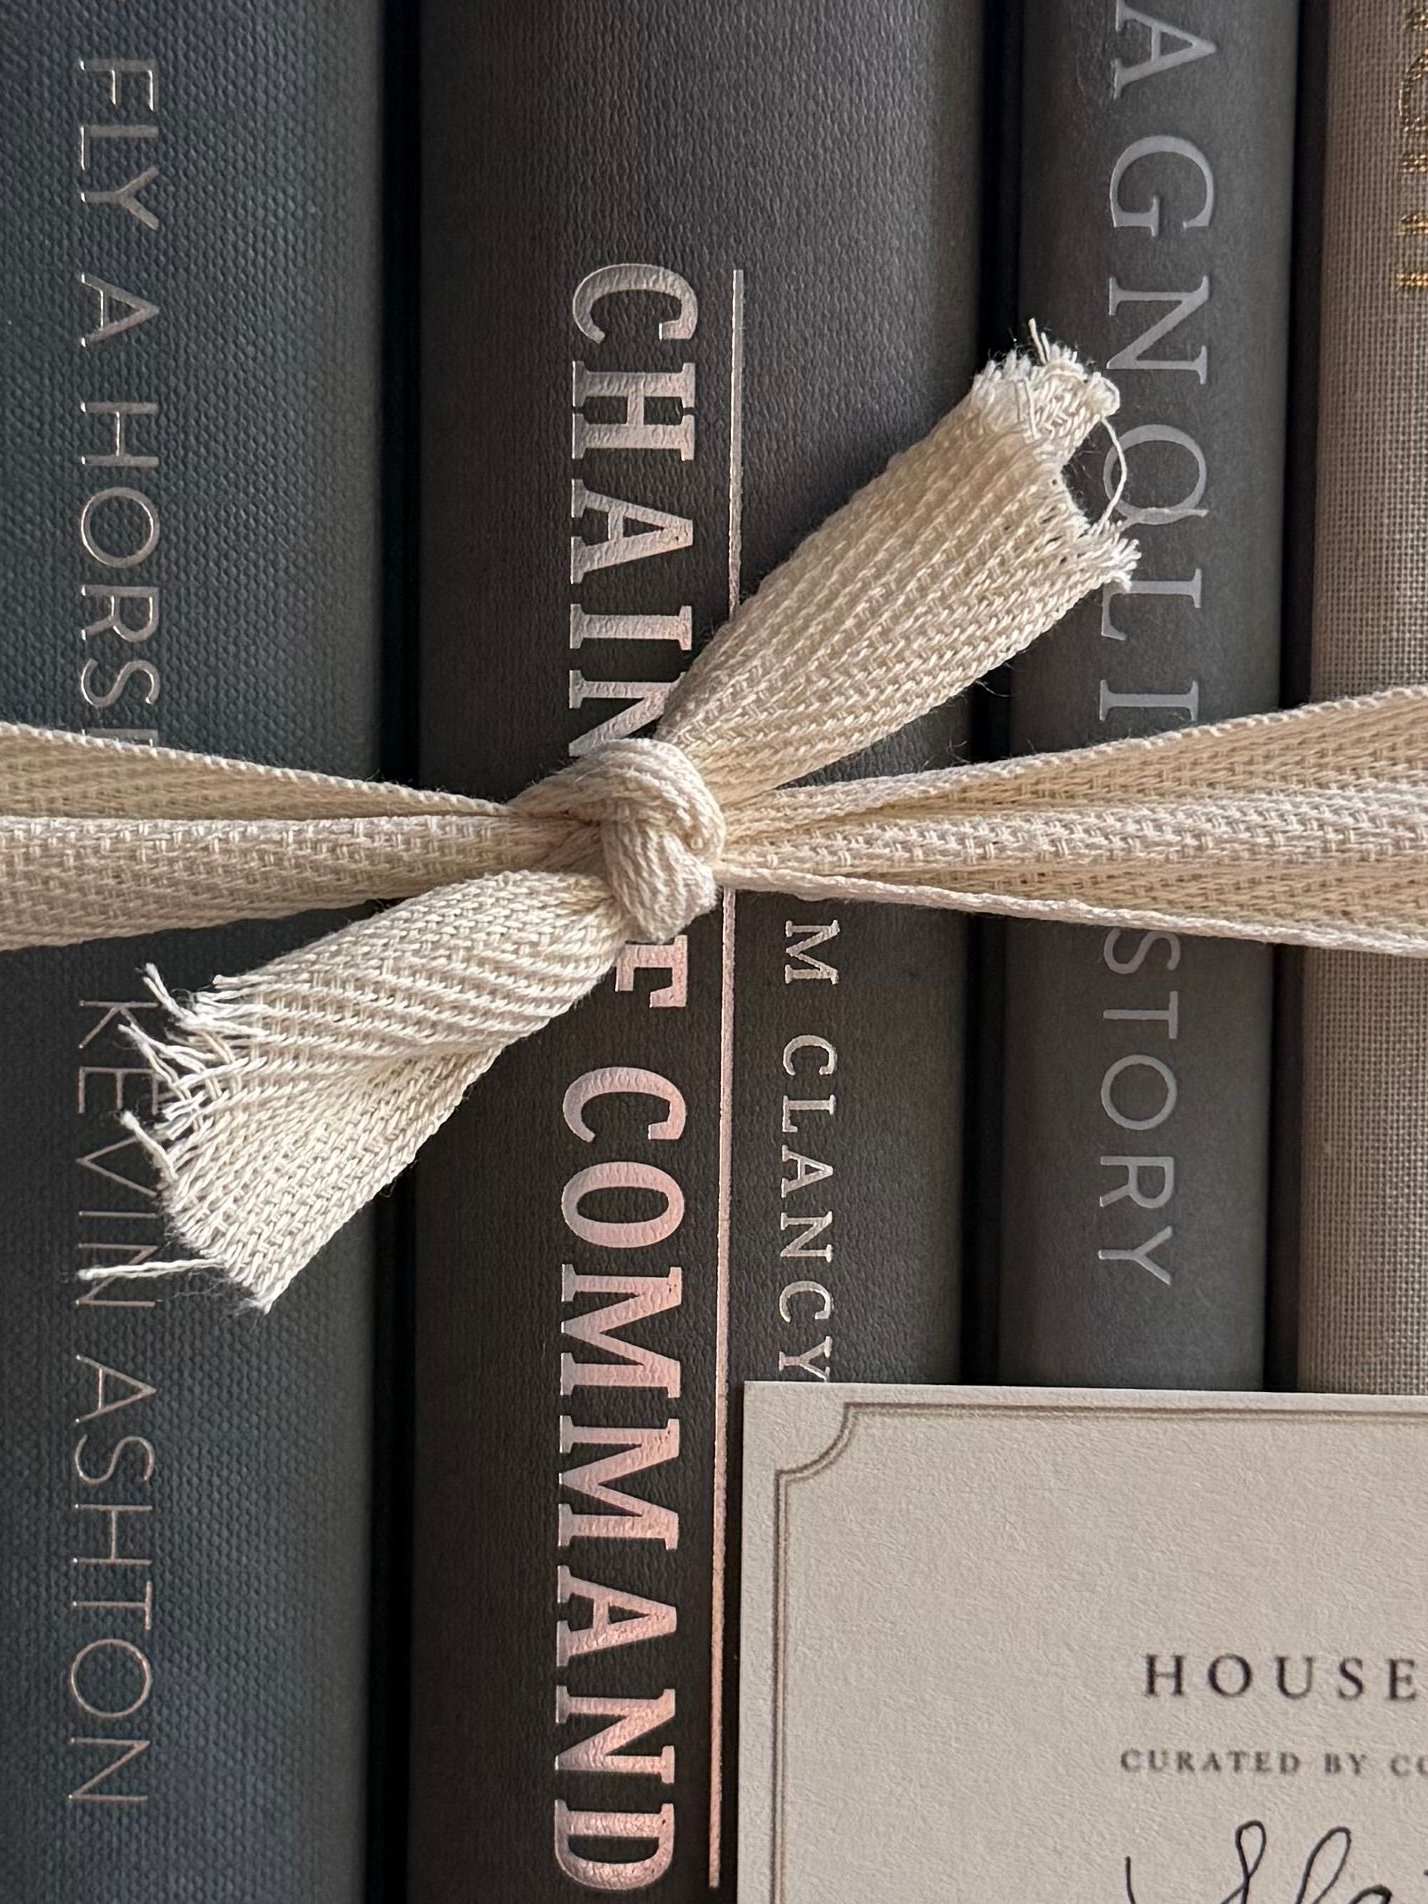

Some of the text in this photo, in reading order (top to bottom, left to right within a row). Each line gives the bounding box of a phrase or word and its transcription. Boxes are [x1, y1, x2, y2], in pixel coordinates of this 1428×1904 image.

[78, 57, 161, 232] FLY
[79, 272, 161, 349] A
[777, 1033, 838, 1384] CLANCY
[1097, 928, 1182, 1287] STORY
[66, 996, 158, 1805] KEVIN ASHTON
[553, 1064, 688, 1892] COMMAND
[1119, 1748, 1302, 1776] CURATED
[1324, 1752, 1367, 1777] BY
[1145, 1653, 1417, 1702] HOUSE
